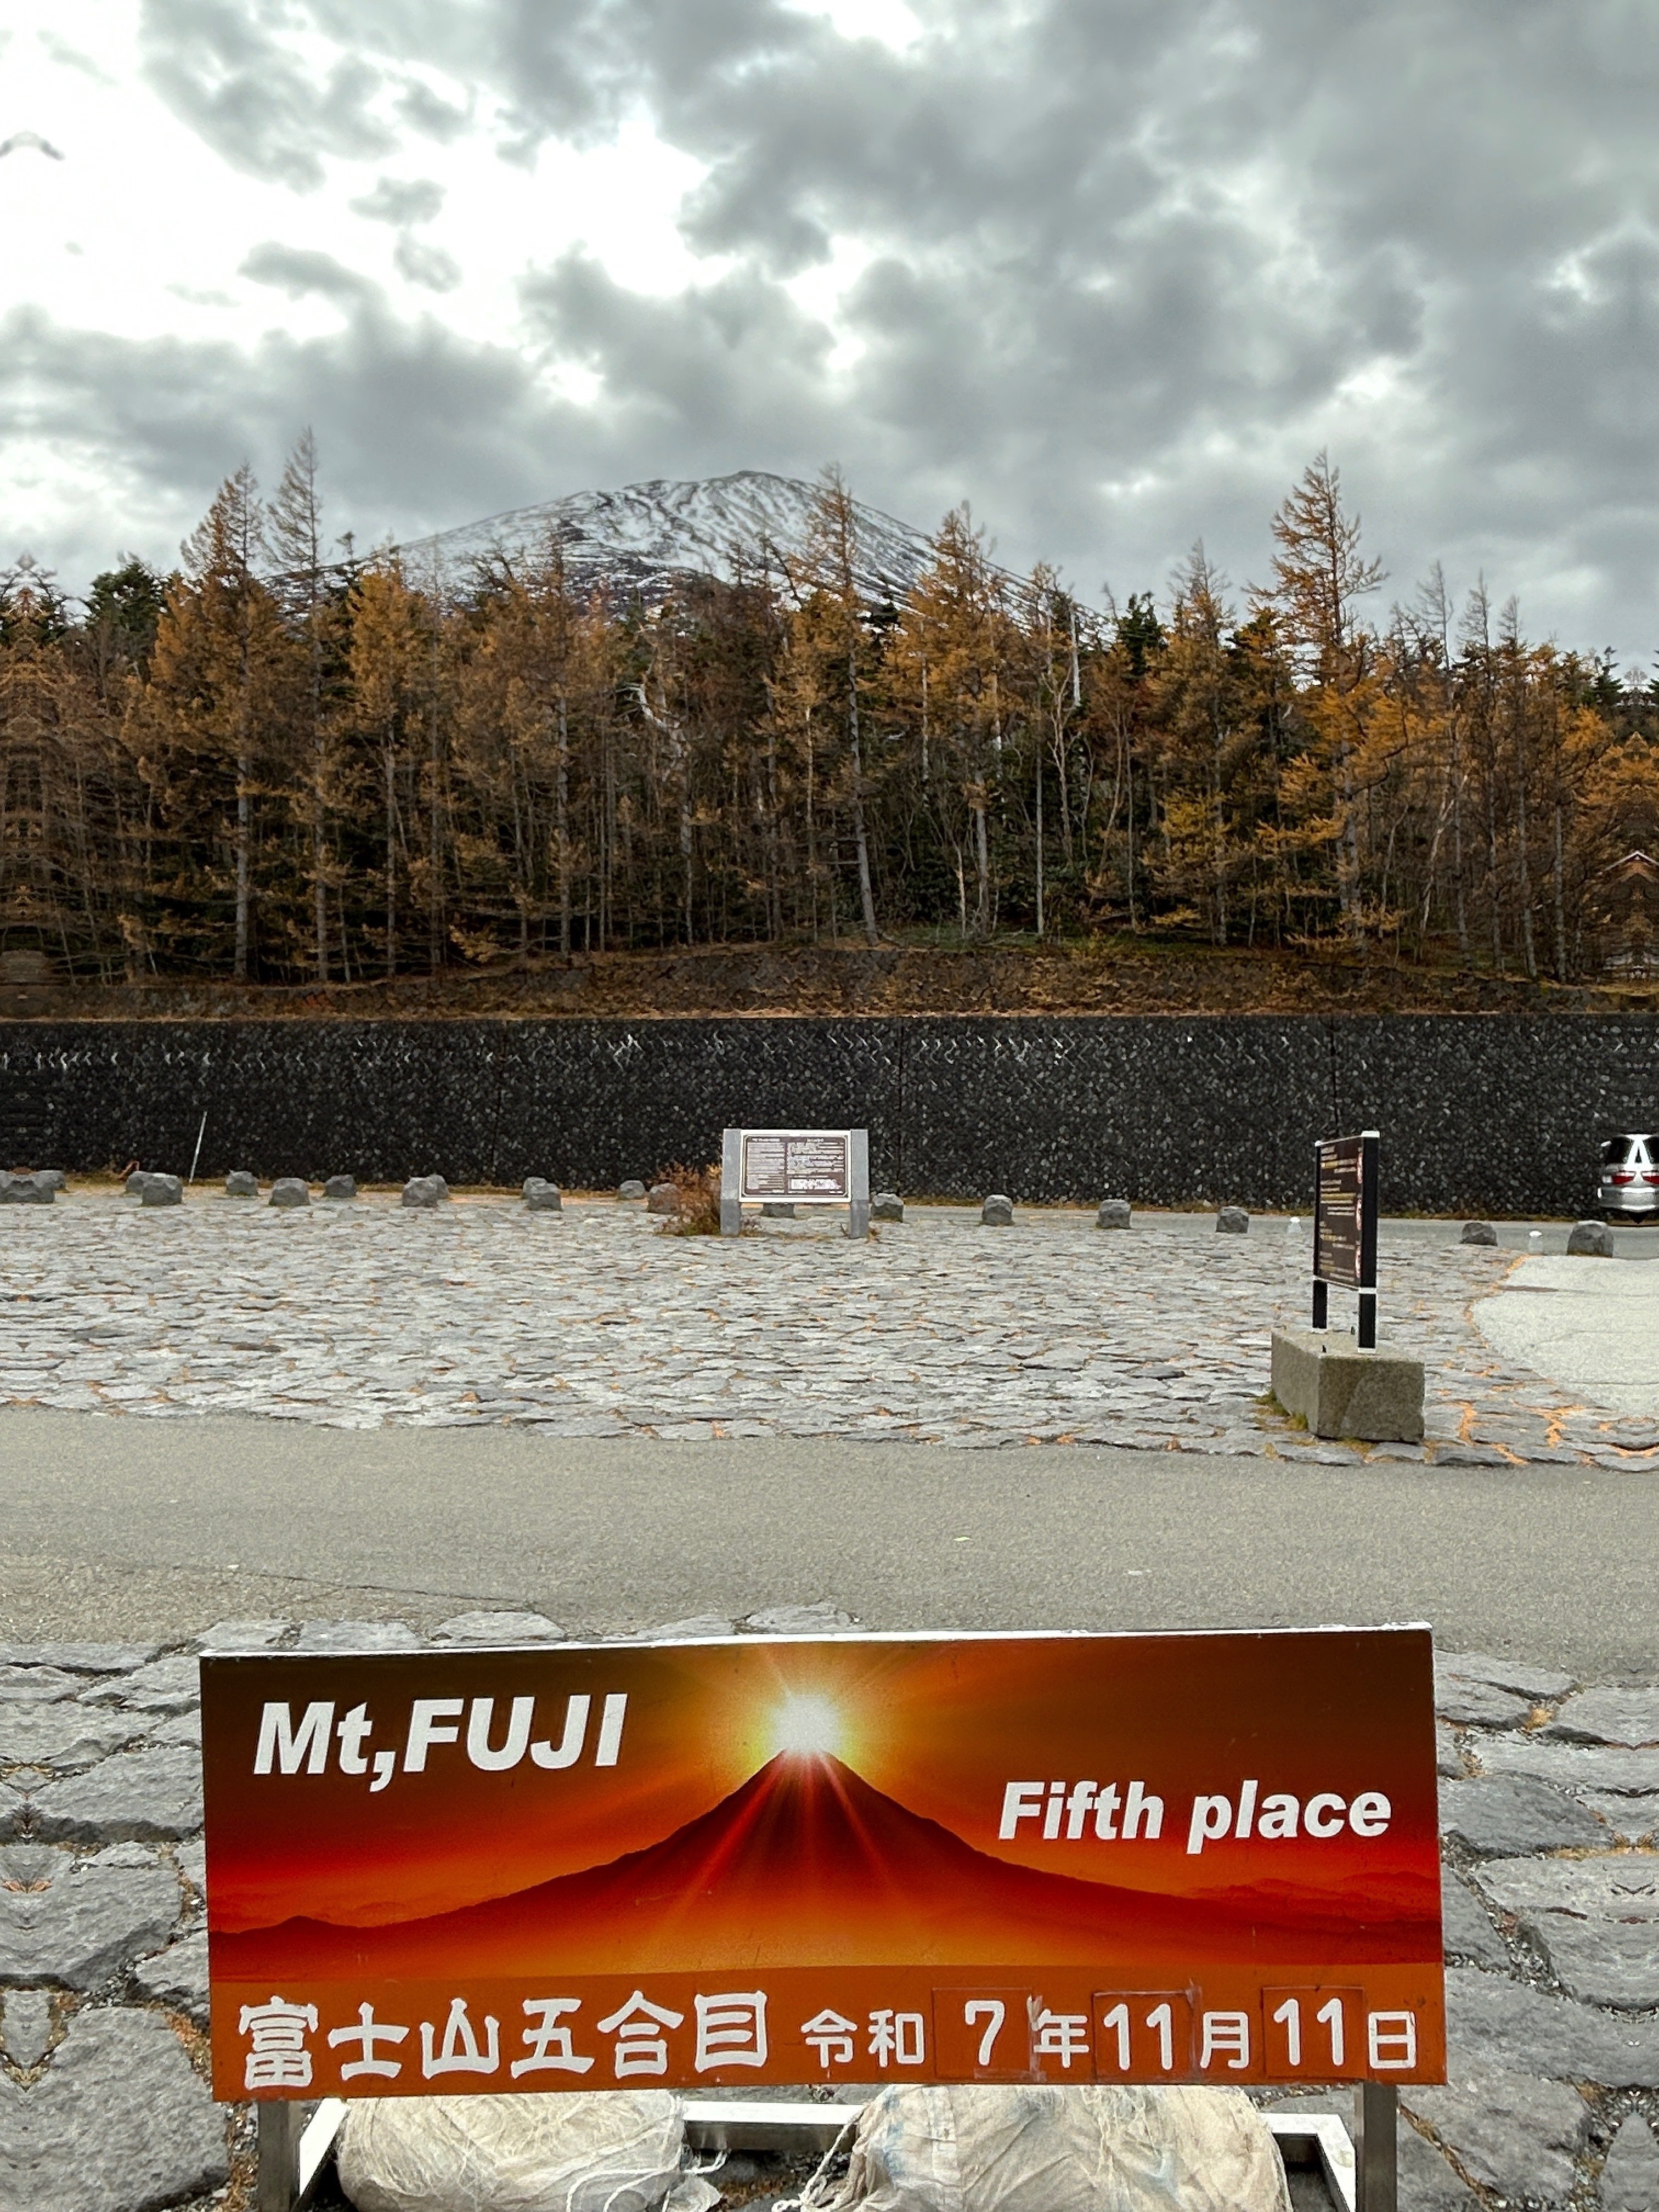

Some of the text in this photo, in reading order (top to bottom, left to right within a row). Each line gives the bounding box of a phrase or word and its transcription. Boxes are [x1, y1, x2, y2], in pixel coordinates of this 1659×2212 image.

[998, 1779, 1392, 1855] Fifth place
[238, 1990, 768, 2091] 富士山五合目
